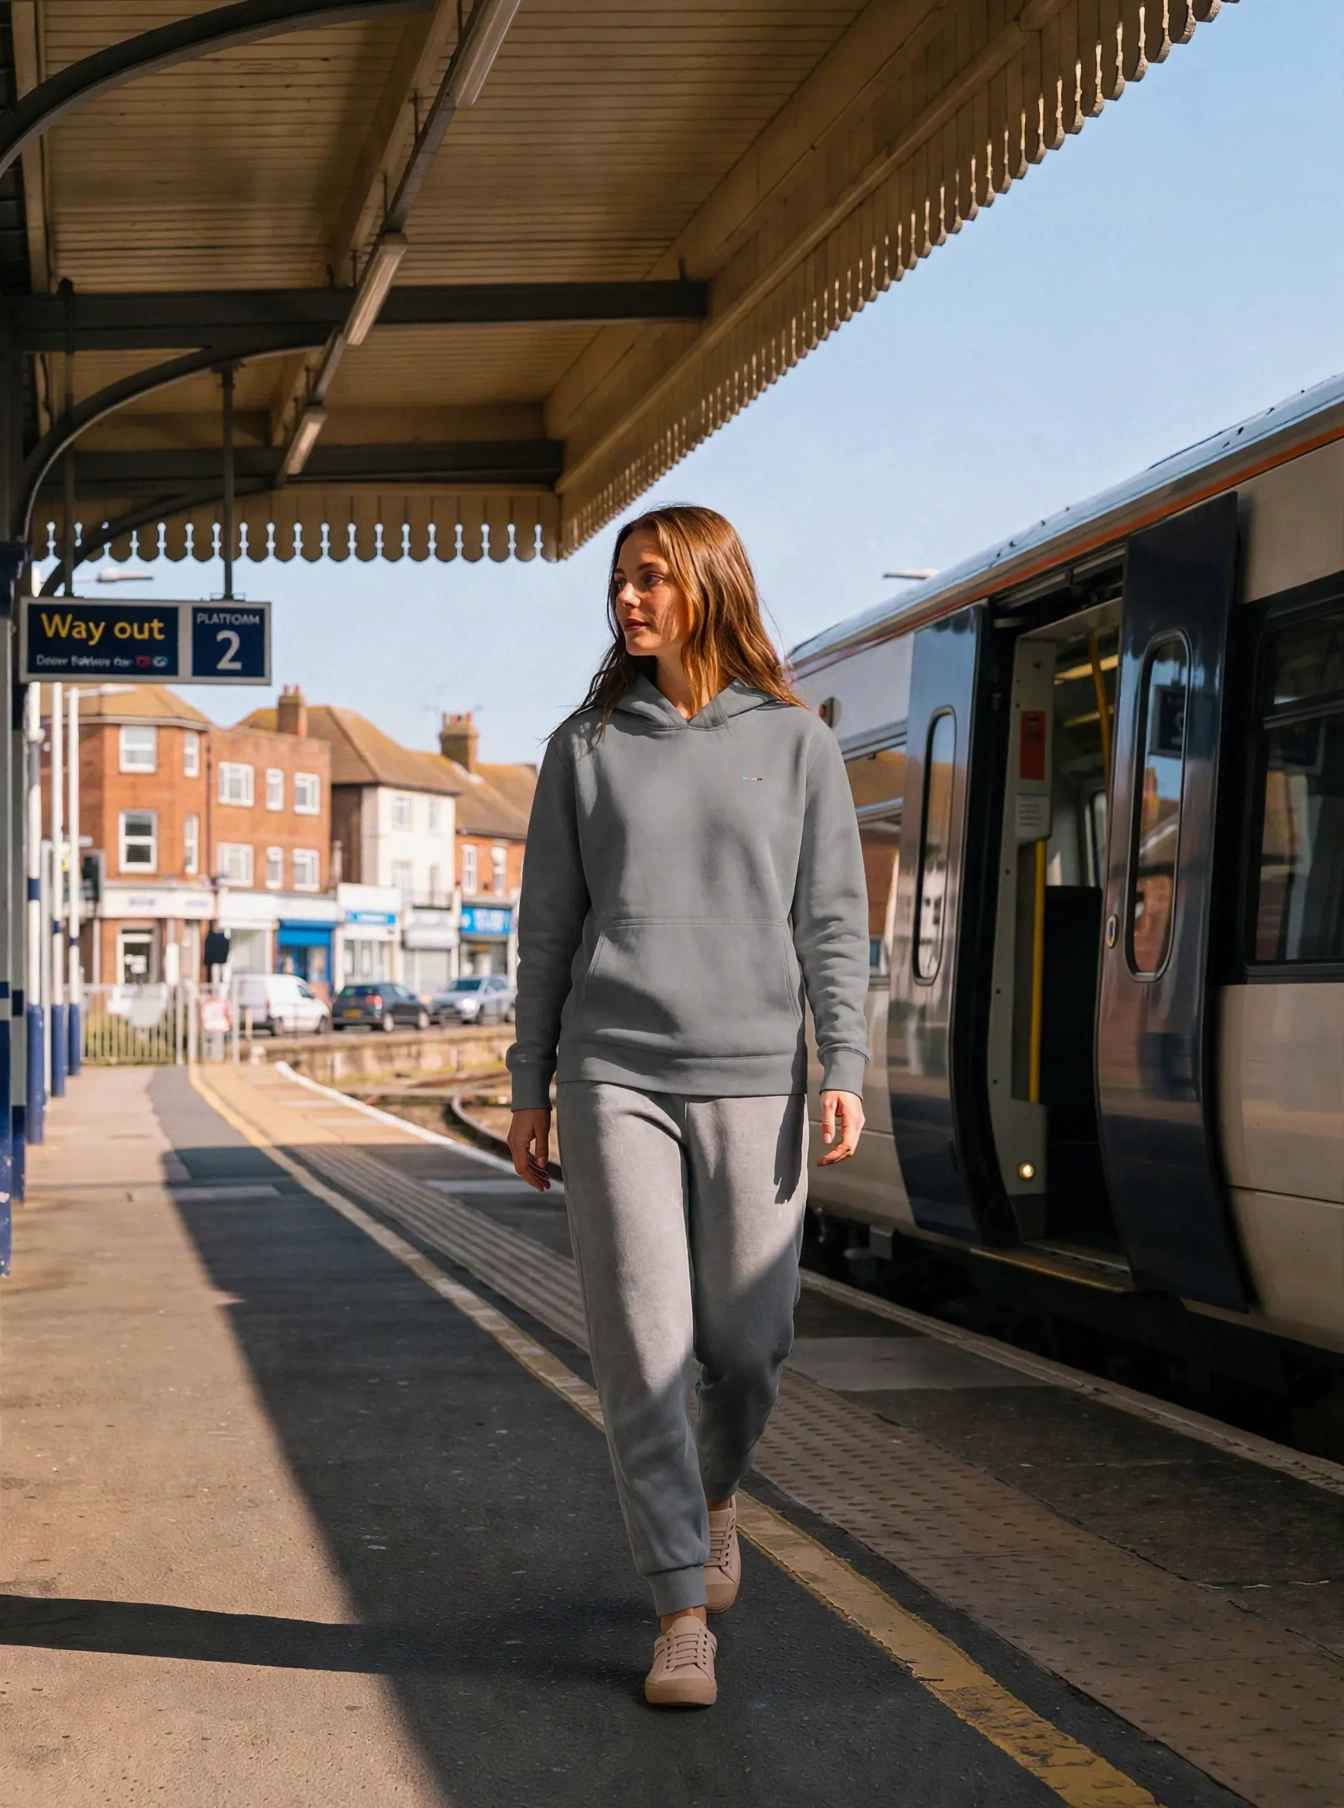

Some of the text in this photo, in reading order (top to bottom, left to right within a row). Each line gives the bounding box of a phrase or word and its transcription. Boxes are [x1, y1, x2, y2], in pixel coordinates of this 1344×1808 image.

[41, 613, 165, 646] Way out
[216, 630, 242, 670] 2
